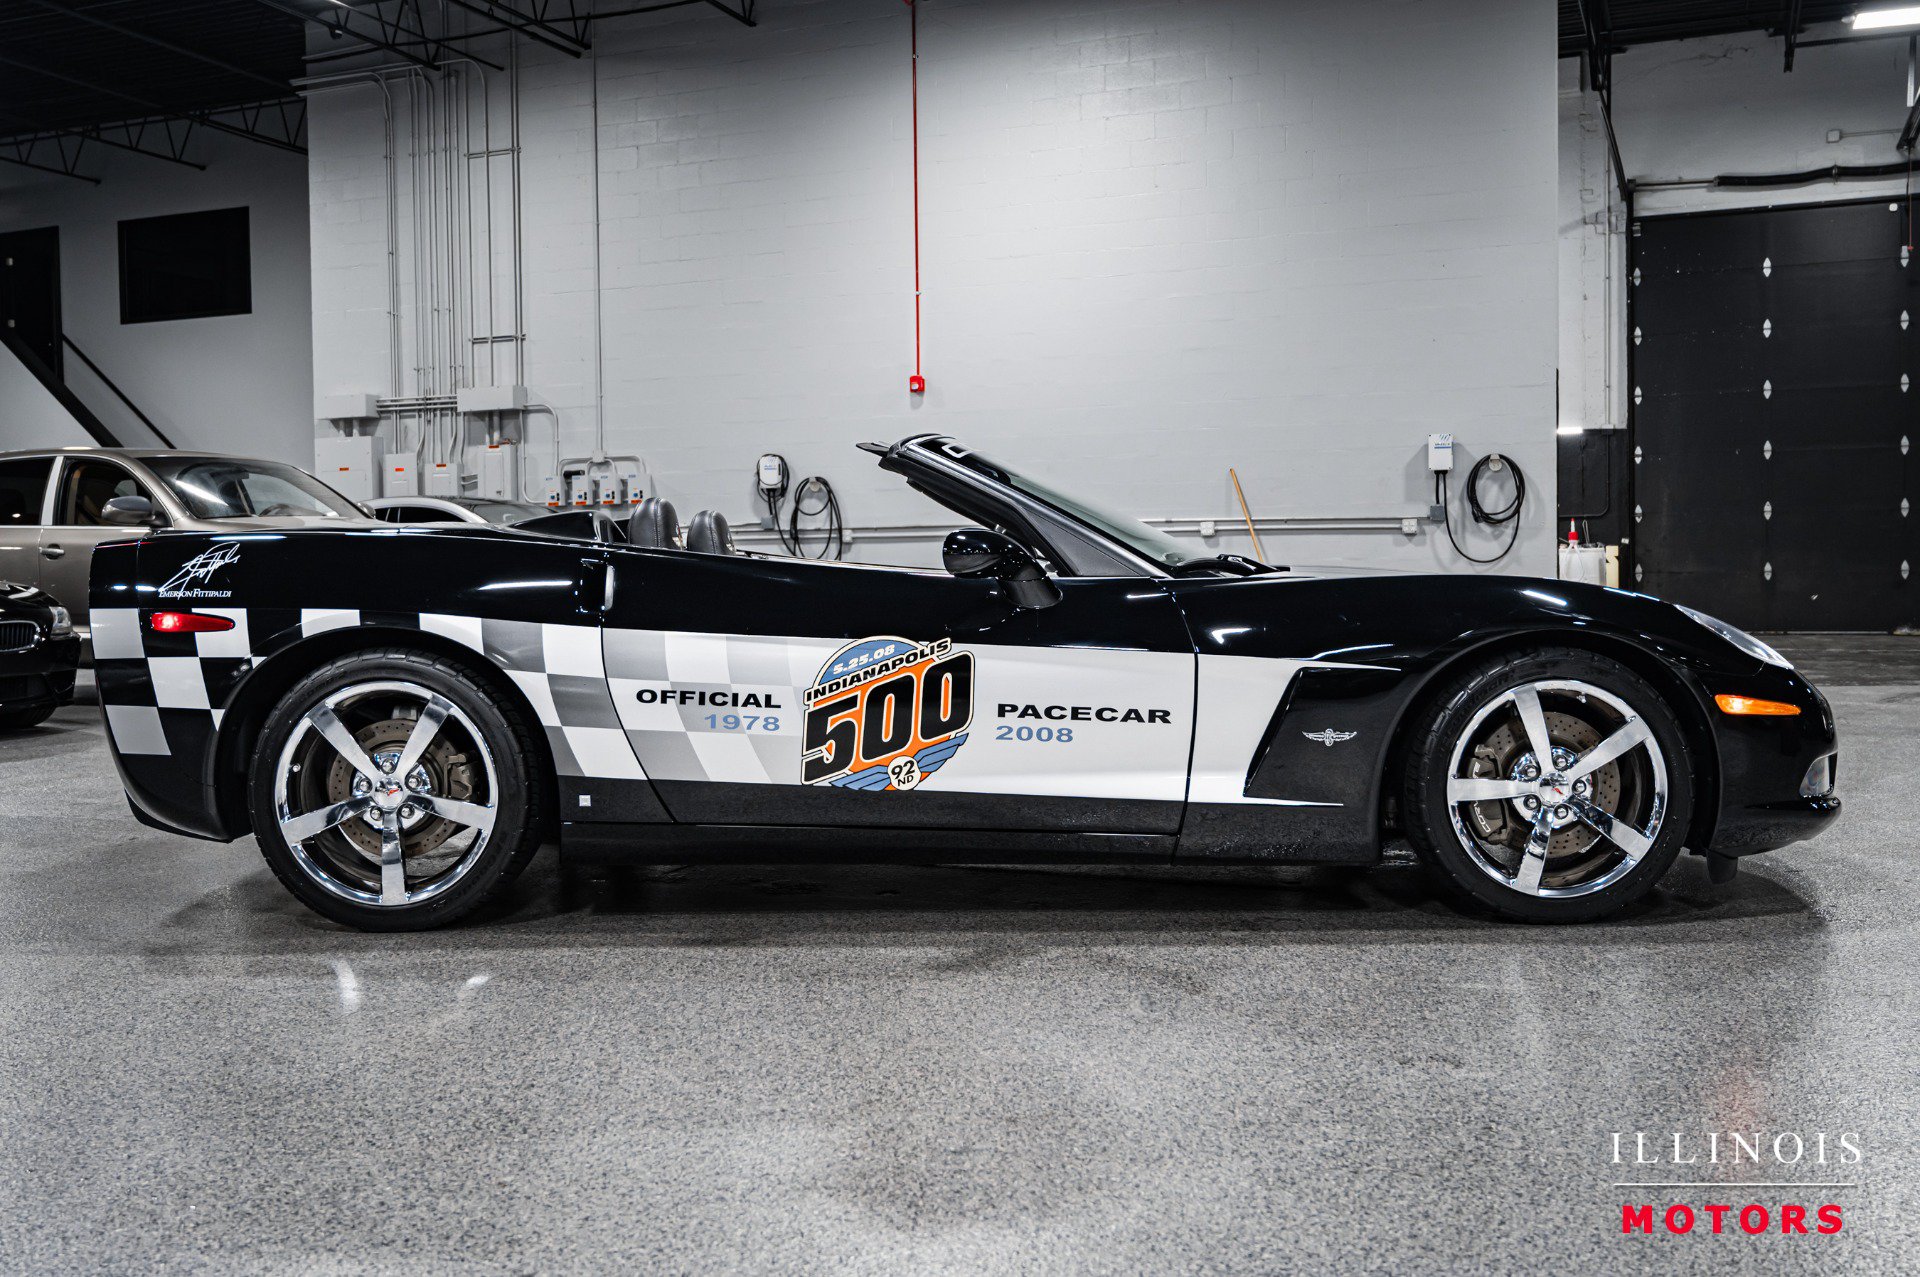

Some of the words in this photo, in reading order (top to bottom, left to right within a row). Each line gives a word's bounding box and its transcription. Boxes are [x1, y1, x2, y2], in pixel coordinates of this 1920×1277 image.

[833, 644, 895, 675] 5.25.08
[806, 640, 950, 703] INDIANAPOLIS
[635, 688, 782, 709] OFFICIAL
[704, 713, 781, 732] 1978
[803, 653, 973, 783] 500
[996, 703, 1172, 725] PACECAR
[995, 725, 1074, 743] 2008
[891, 759, 916, 780] 92
[897, 774, 915, 787] ND
